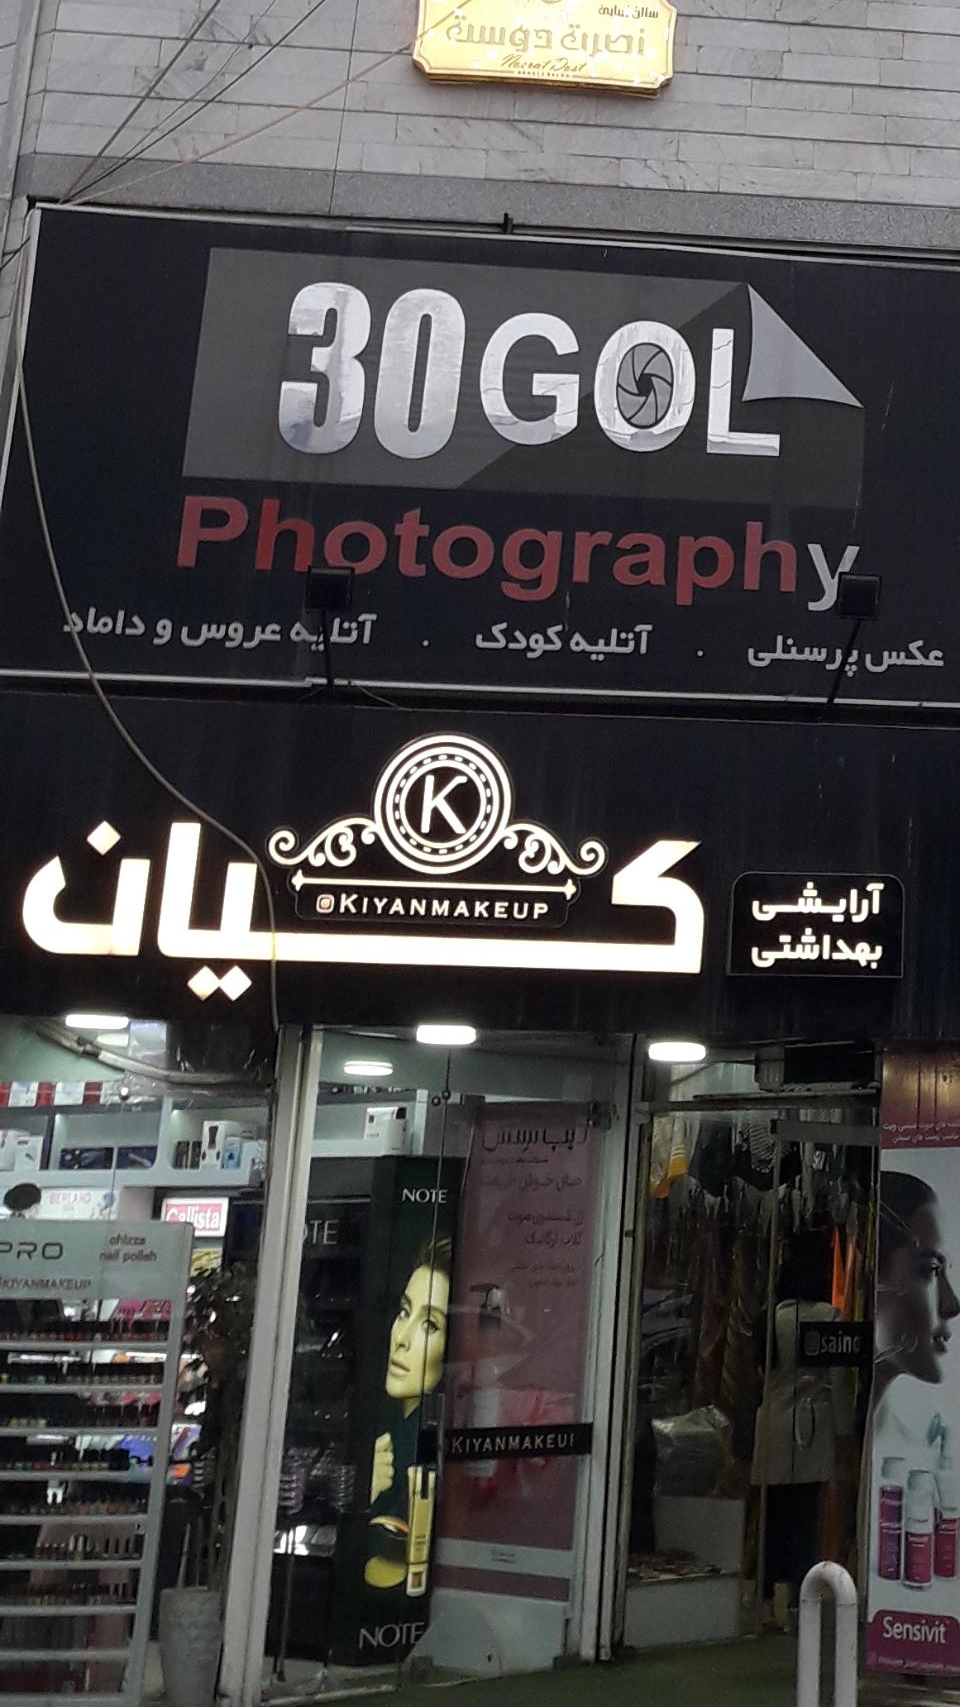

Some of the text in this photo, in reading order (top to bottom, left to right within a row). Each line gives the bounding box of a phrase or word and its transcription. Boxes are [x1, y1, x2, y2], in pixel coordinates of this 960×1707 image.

[277, 280, 781, 460] 30GOL
[175, 494, 860, 612] Photography
[62, 606, 146, 637] داماد
[153, 618, 173, 646] و
[180, 618, 282, 650] عروس
[474, 621, 654, 662] آتلیه کودک
[746, 634, 945, 677] عکس پرسنلی
[21, 819, 704, 1002] کیان
[751, 880, 885, 923] آرایشی
[750, 927, 883, 970] بهداشتی
[401, 1187, 449, 1205] NOTE
[359, 1620, 425, 1651] NOTE
[882, 1615, 947, 1645] Sensivit
